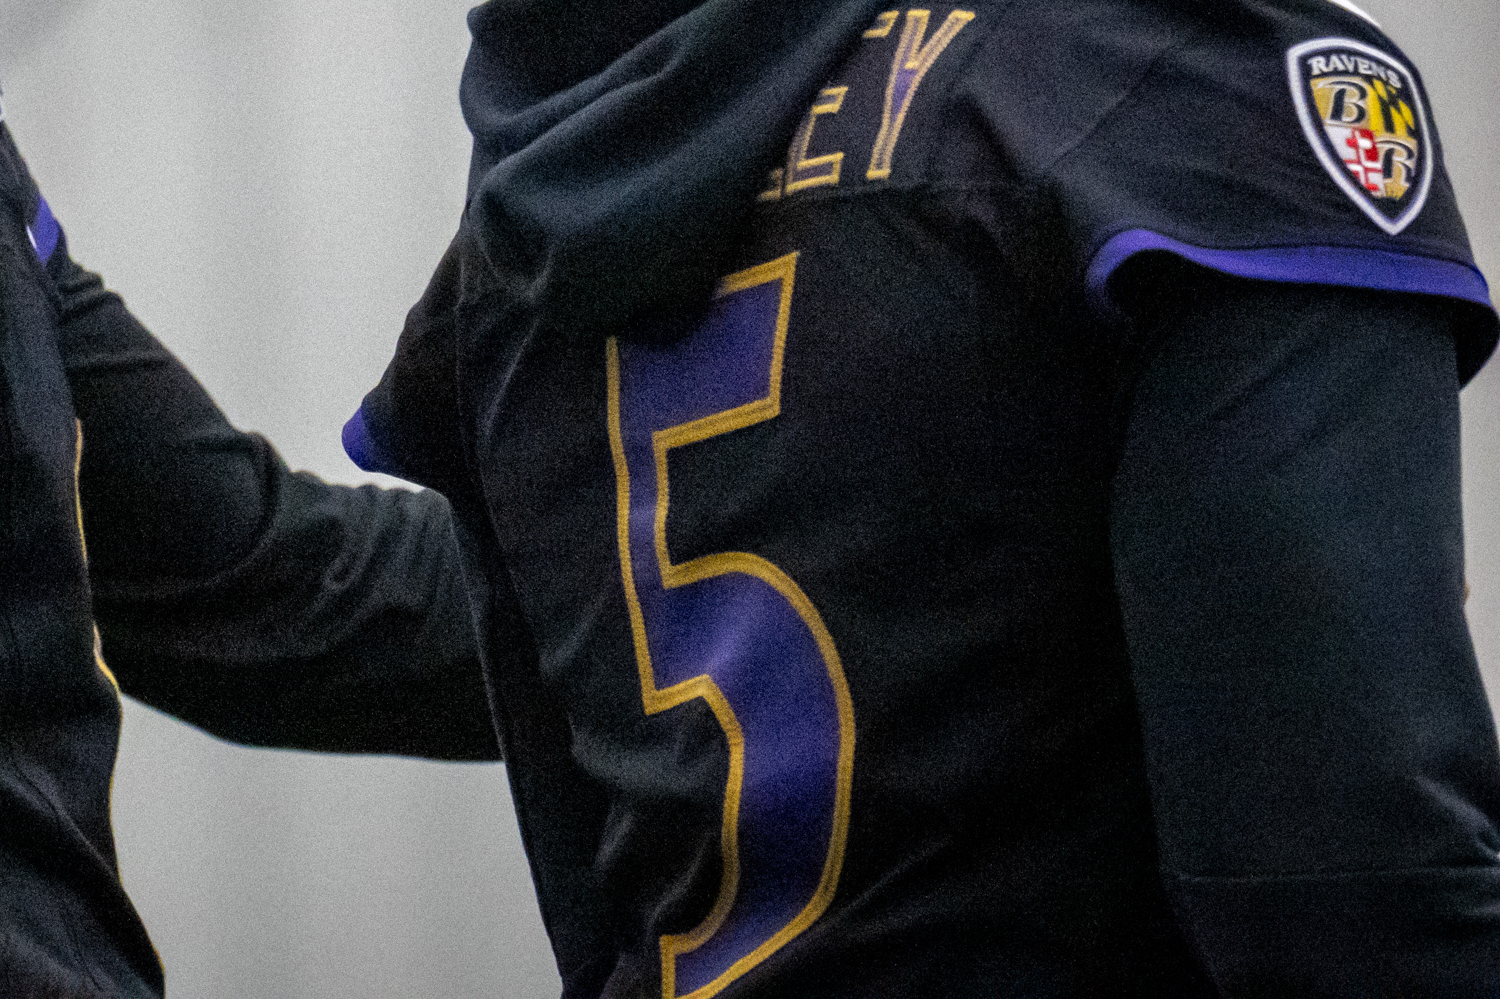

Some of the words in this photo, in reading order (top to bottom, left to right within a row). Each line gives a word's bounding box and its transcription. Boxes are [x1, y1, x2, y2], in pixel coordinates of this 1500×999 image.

[758, 9, 976, 200] EY
[1308, 54, 1402, 90] RAVENS
[607, 251, 856, 999] 5
